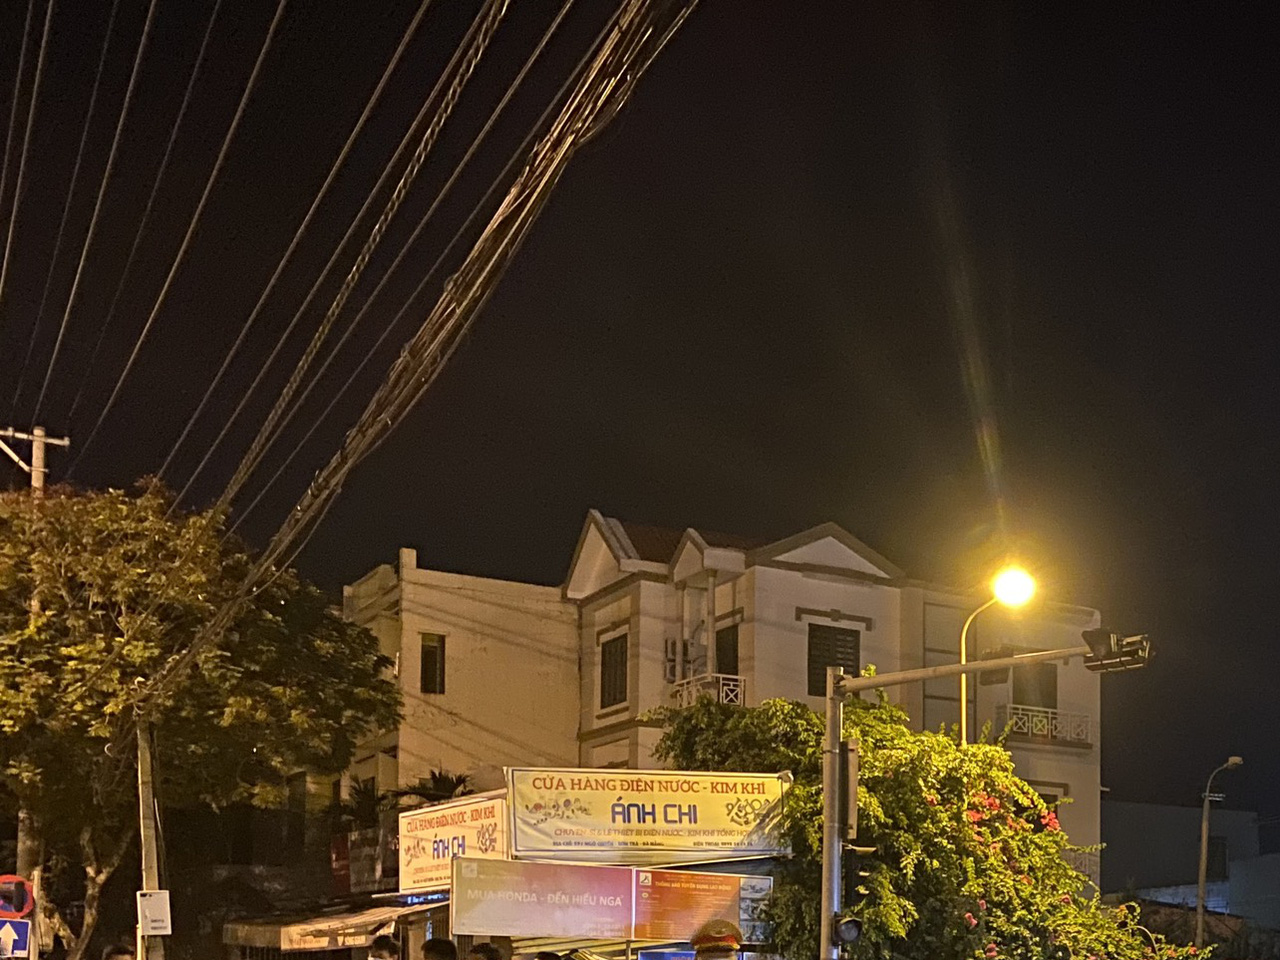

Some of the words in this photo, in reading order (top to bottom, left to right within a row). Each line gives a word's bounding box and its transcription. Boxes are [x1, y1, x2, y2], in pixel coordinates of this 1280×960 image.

[532, 775, 566, 790] CỬA
[571, 776, 617, 791] HÀNG
[620, 778, 654, 794] ĐIỆN
[658, 779, 700, 793] NƯỚC
[710, 782, 738, 794] KIM
[741, 782, 766, 794] KHÍ
[611, 796, 657, 824] ÁNH
[663, 804, 698, 824] CHI
[432, 833, 450, 860] ÁNH
[451, 835, 466, 858] CHI
[467, 889, 498, 900] MUA
[499, 890, 537, 902] HONDA
